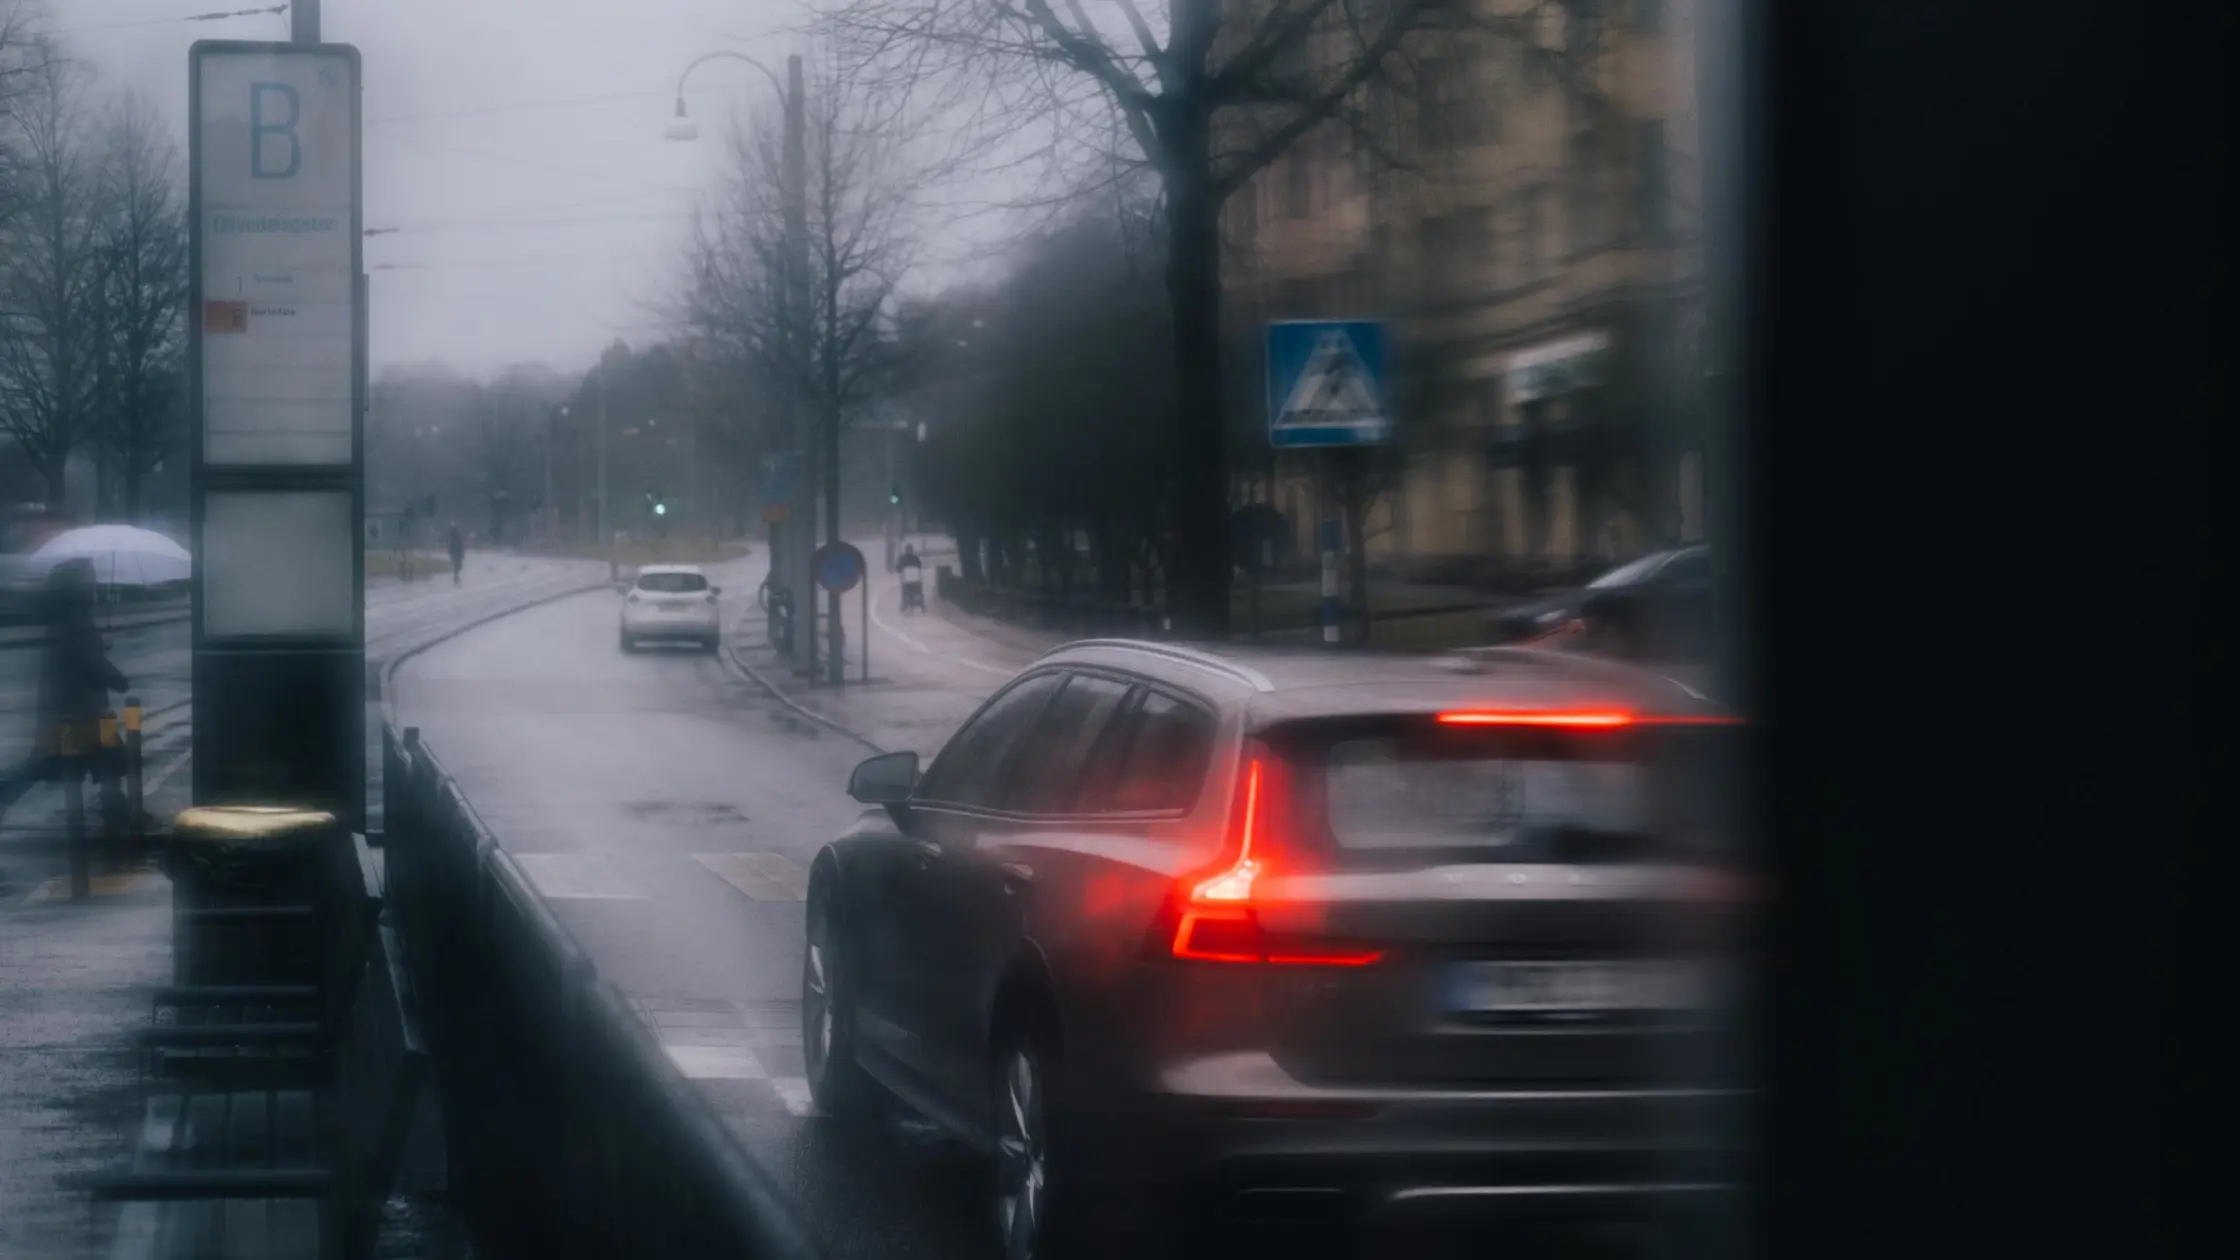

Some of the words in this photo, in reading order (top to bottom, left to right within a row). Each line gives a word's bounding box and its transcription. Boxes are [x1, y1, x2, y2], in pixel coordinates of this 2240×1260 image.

[250, 81, 301, 179] B
[236, 276, 243, 294] 1
[232, 308, 244, 327] 6
